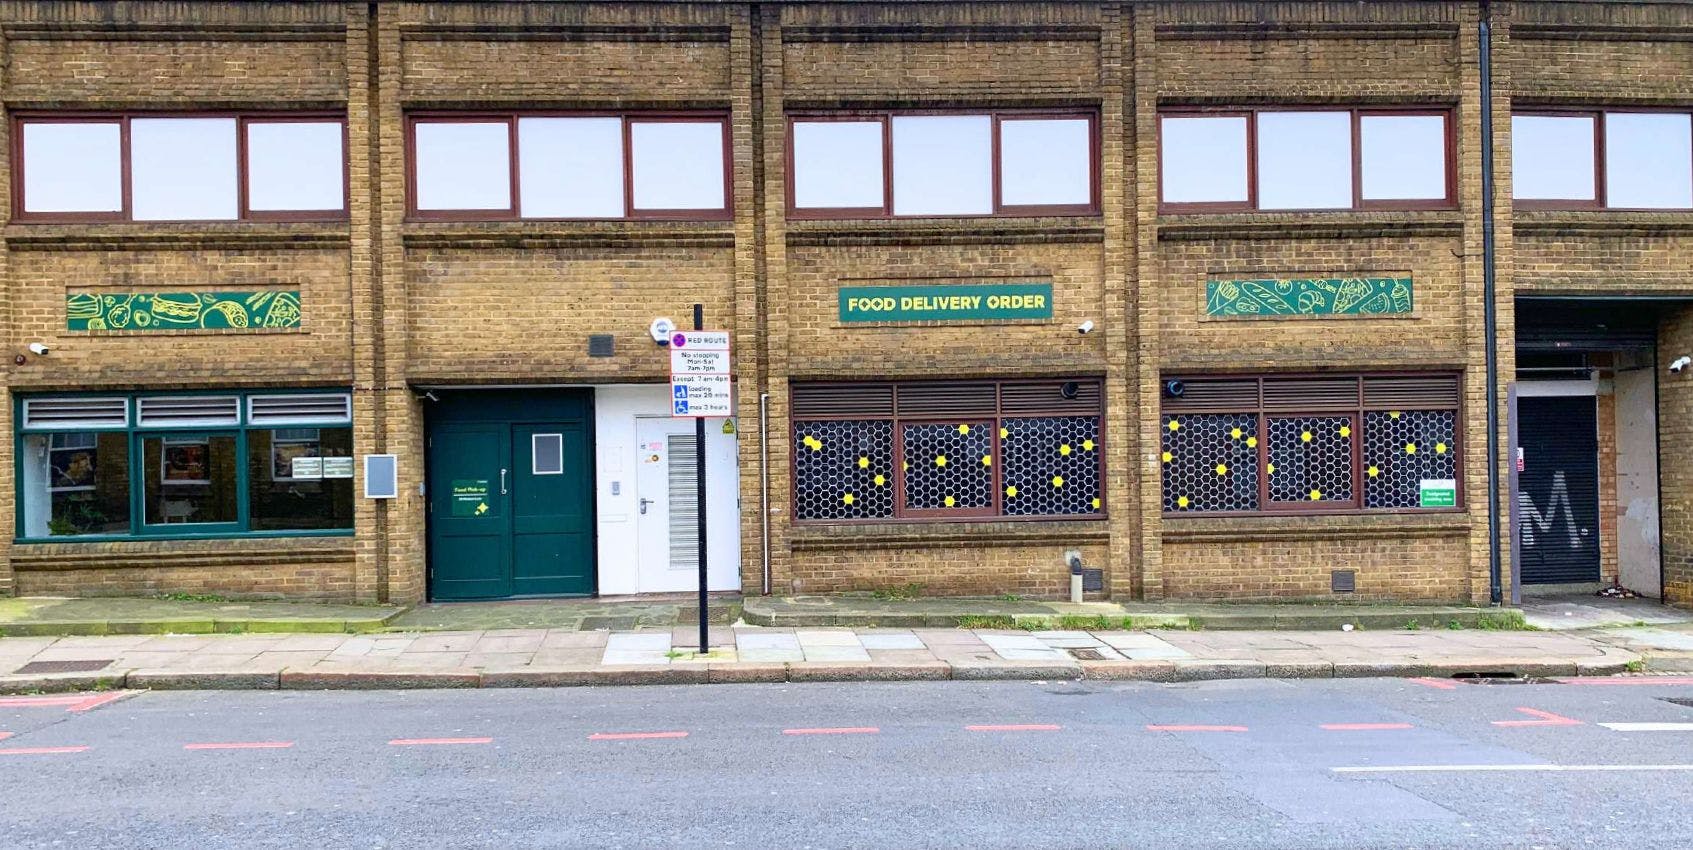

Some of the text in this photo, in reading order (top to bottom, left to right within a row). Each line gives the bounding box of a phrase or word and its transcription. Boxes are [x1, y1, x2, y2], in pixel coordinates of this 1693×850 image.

[848, 295, 1046, 311] FOOD DELIVERY ORDER
